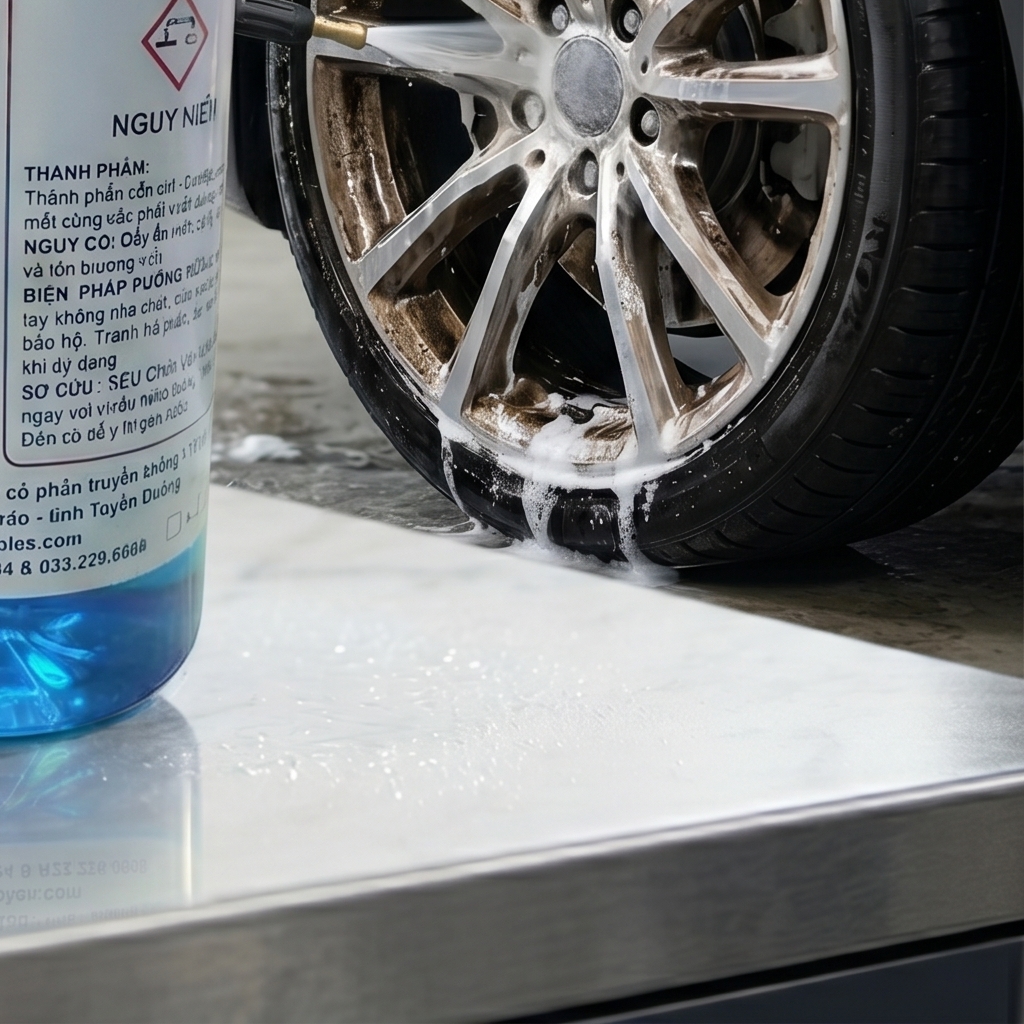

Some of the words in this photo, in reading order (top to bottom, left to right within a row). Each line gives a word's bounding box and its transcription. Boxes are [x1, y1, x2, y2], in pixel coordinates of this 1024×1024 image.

[112, 108, 179, 137] NGUY
[24, 164, 91, 182] THANH
[61, 212, 103, 231] cùng
[24, 236, 80, 255] NGUY
[23, 262, 43, 279] và
[23, 284, 69, 306] BIỆN
[79, 277, 127, 300] PHÁP
[23, 312, 49, 331] tay
[55, 307, 105, 326] không
[110, 303, 137, 321] nha
[94, 328, 139, 346] Tranh
[22, 360, 46, 375] khi
[78, 354, 117, 374] dang
[22, 409, 63, 427] ngay
[21, 560, 32, 575] &
